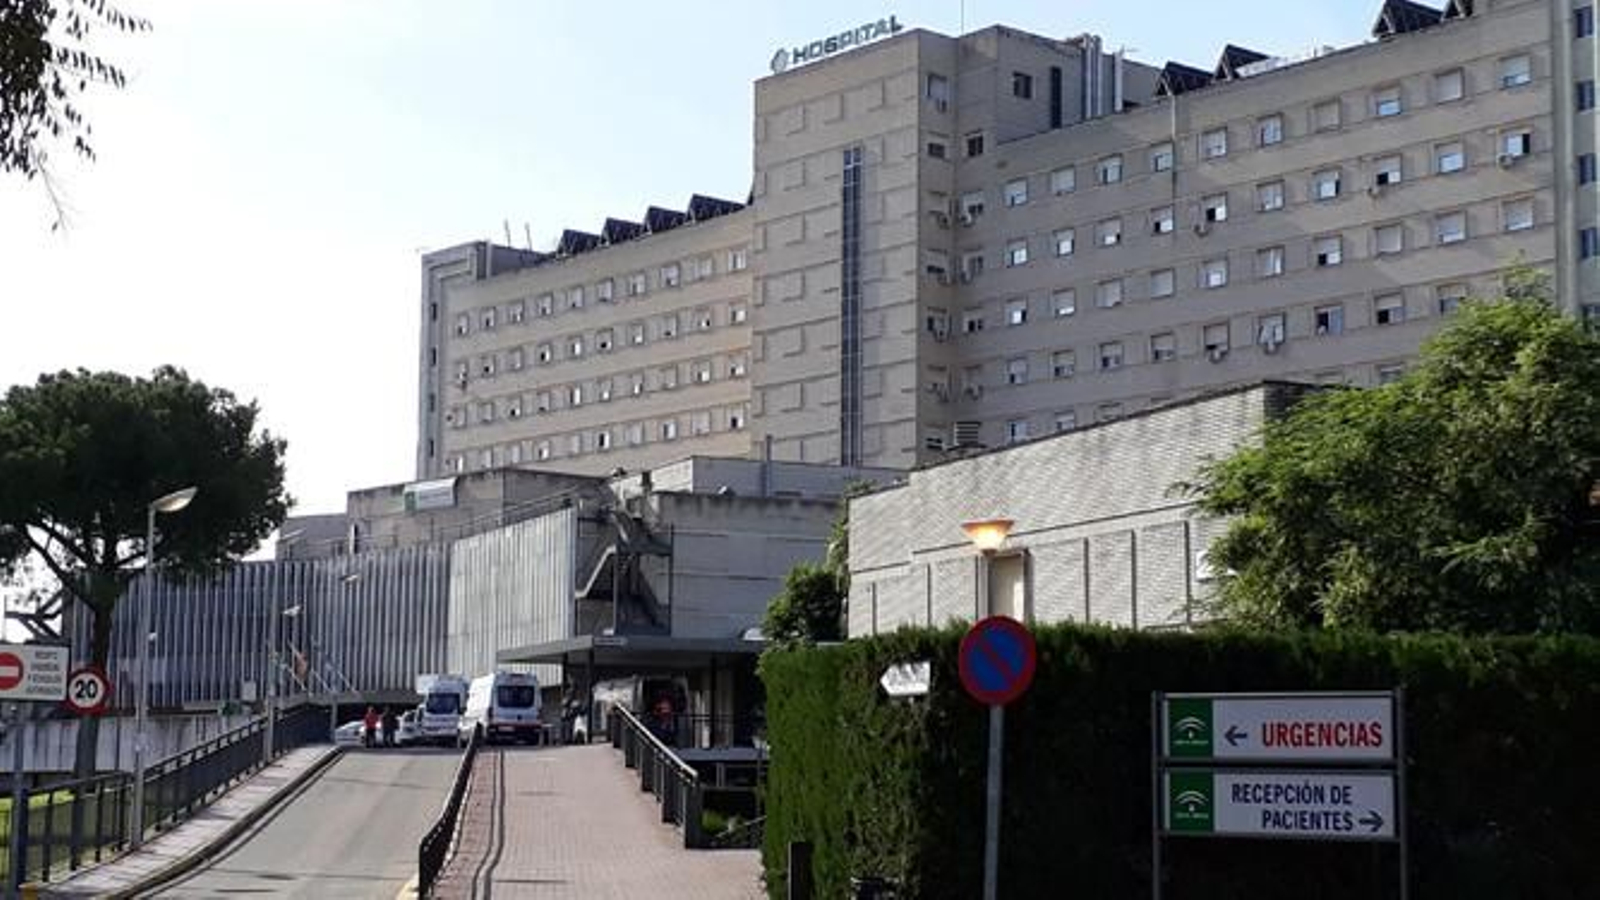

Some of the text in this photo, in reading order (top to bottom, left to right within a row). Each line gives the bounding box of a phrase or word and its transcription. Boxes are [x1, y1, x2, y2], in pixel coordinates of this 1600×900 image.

[792, 15, 903, 64] HOSPITAL
[75, 678, 98, 699] 20
[1262, 721, 1383, 747] URGENCIAS
[1231, 781, 1353, 805] RECEPCIÓN DE
[1262, 809, 1354, 832] PACIENTES
